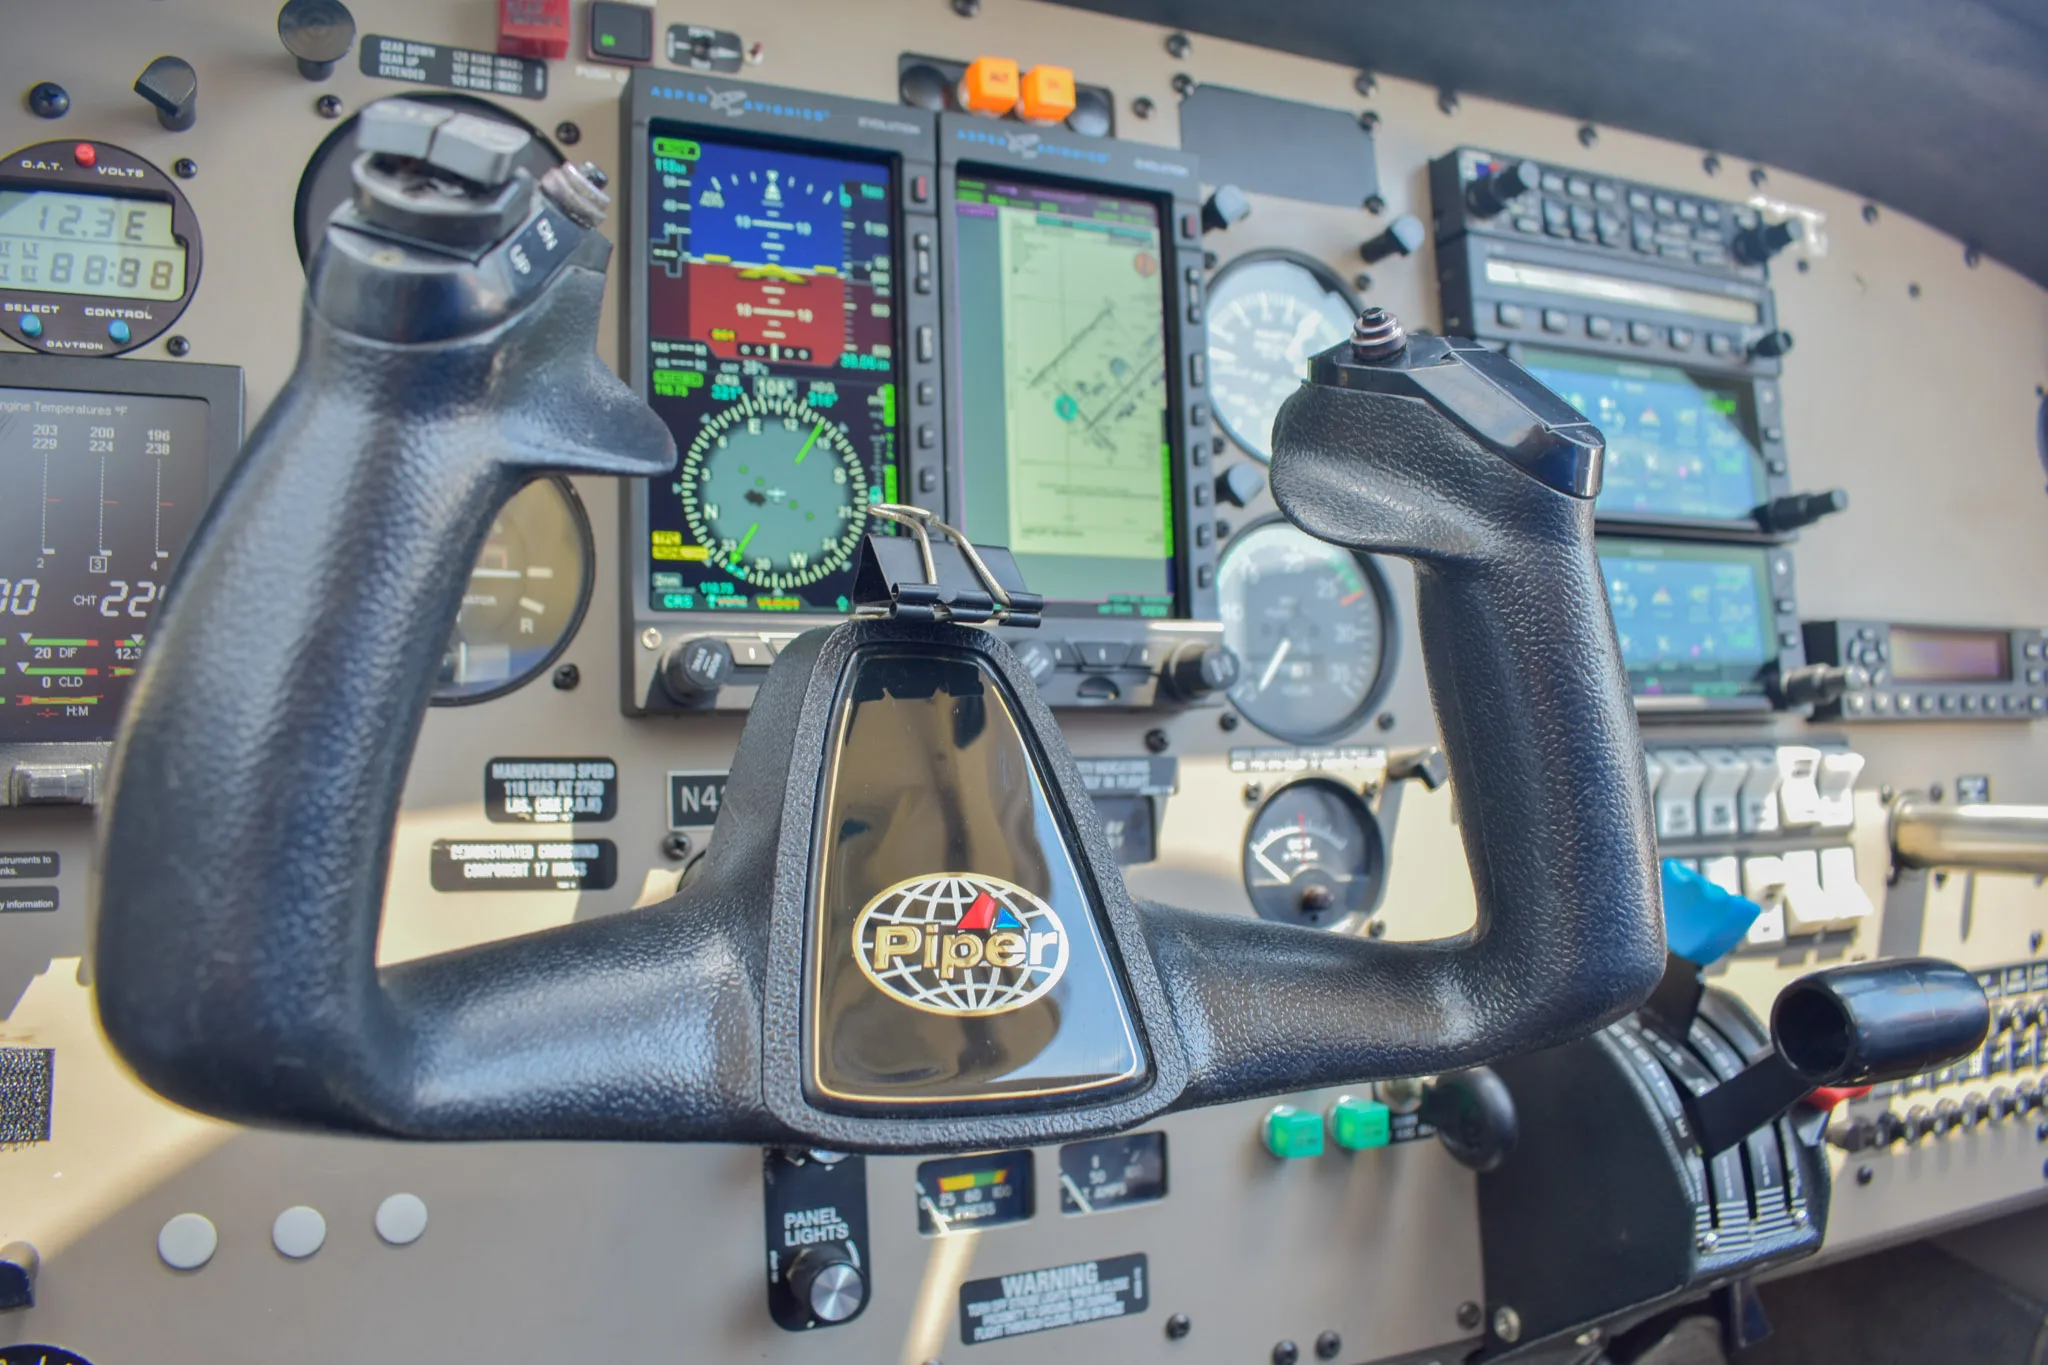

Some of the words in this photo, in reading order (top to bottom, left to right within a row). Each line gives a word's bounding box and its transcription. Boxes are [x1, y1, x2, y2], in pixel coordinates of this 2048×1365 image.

[21, 159, 64, 171] O.A.T.
[97, 165, 145, 178] VOLTS
[509, 244, 531, 275] UP
[4, 302, 60, 315] SELECT
[84, 307, 153, 320] CONTROL
[34, 401, 113, 416] Temperatures
[33, 424, 58, 436] 203
[90, 427, 115, 439] 200
[748, 418, 761, 435] E
[147, 429, 171, 442] 196
[32, 438, 58, 450] 229
[89, 440, 114, 453] 224
[701, 467, 711, 482] 3
[703, 503, 720, 521] N
[37, 557, 45, 569] 2
[94, 559, 102, 570] 3
[150, 561, 158, 571] 4
[789, 551, 808, 569] W
[73, 595, 98, 606] CHT
[100, 580, 167, 618] 22
[519, 617, 534, 634] R
[34, 647, 52, 660] 20
[59, 647, 78, 658] DIF
[42, 678, 51, 689] 0
[58, 677, 83, 688] CLD
[66, 706, 89, 717] H:M
[577, 763, 615, 780] SPEED
[557, 780, 574, 796] AT
[681, 784, 726, 814] N4
[43, 855, 52, 864] to
[463, 861, 530, 878] COMPONENT
[534, 861, 549, 878] 17
[6, 900, 55, 910] information
[873, 922, 1058, 979] Piper
[783, 1207, 842, 1230] PANEL
[784, 1222, 850, 1247] LIGHTS
[1001, 1261, 1099, 1299] WARNING
